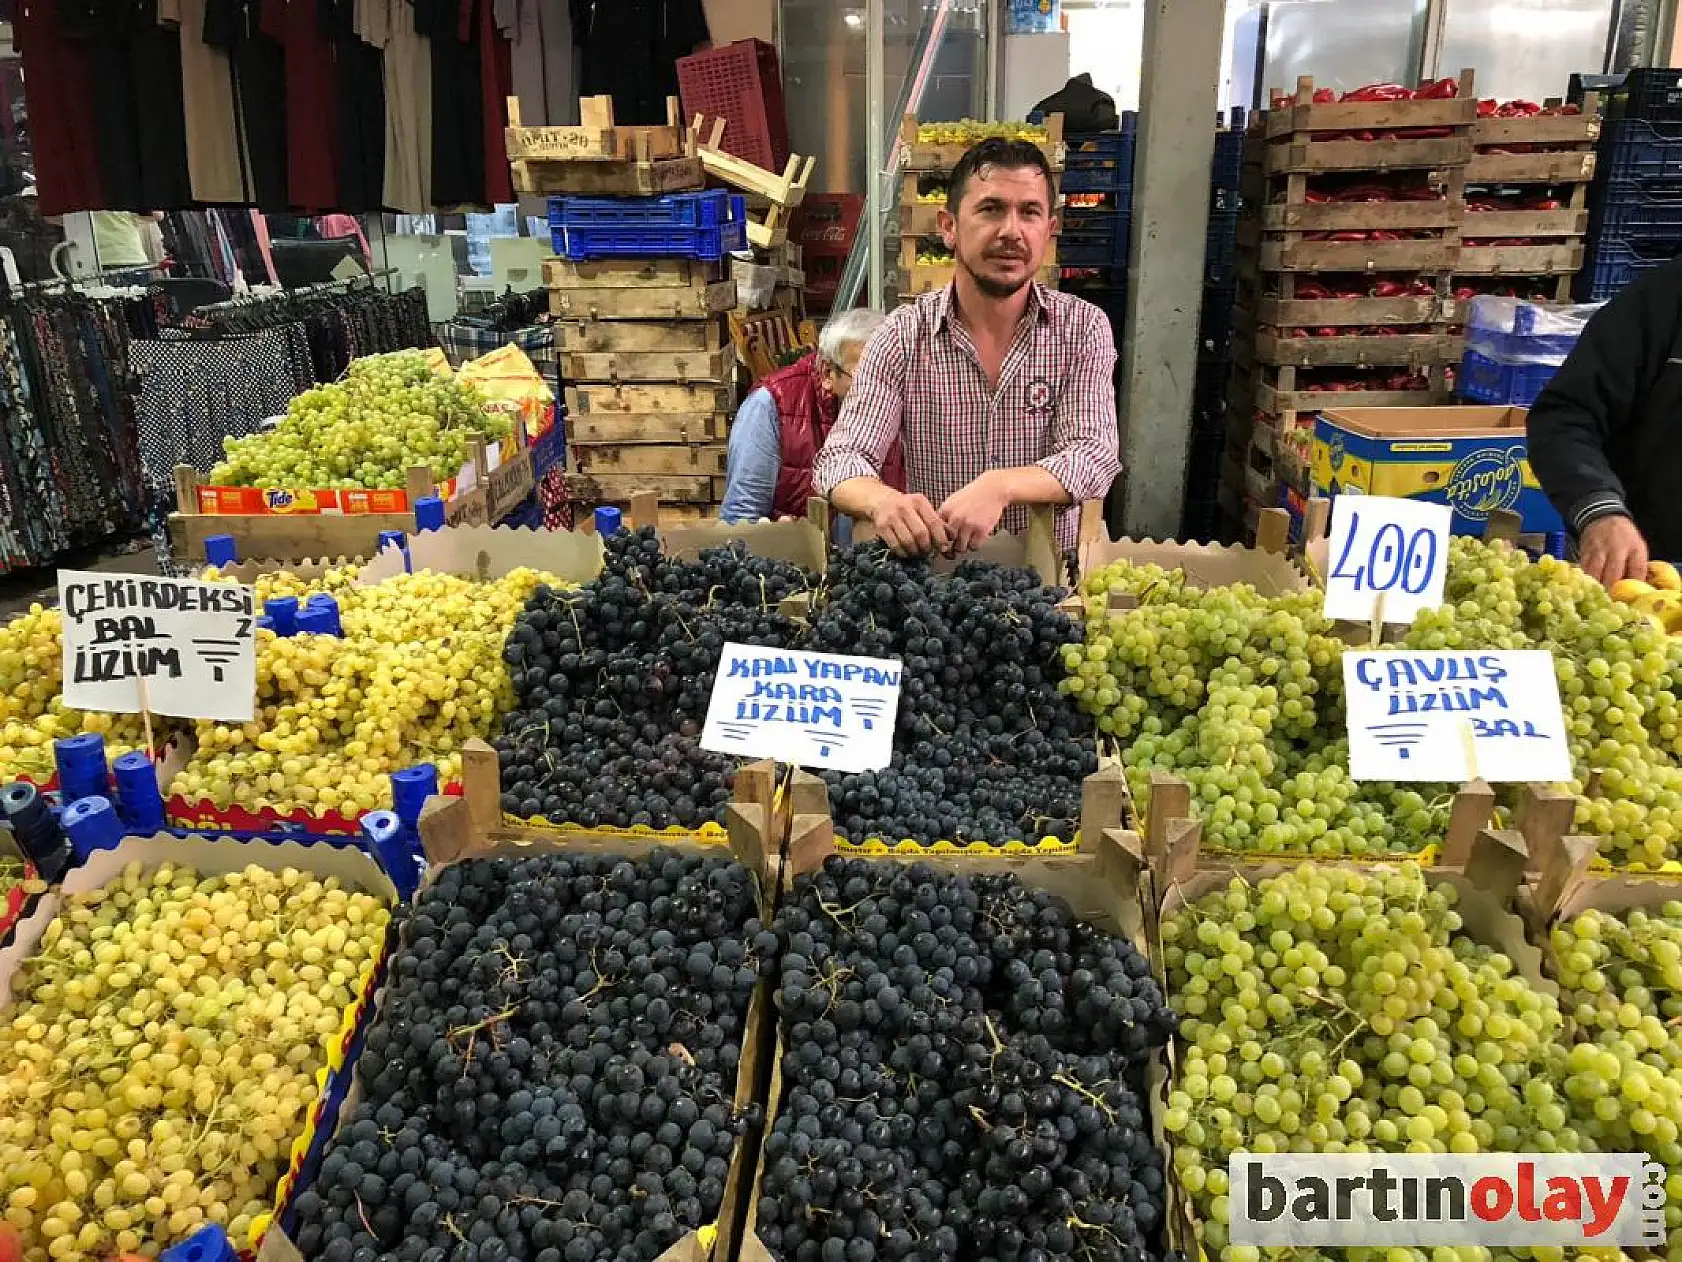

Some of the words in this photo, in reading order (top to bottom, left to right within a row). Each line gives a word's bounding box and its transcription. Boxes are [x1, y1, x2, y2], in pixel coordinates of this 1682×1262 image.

[266, 490, 293, 508] Tide
[1331, 511, 1437, 594] 400
[90, 615, 172, 645] BAL
[74, 643, 182, 683] ÜZÜM
[727, 656, 797, 678] KAN
[803, 658, 899, 686] YAPAN
[1356, 656, 1508, 691] ÇAVUŞ
[745, 680, 842, 702] KARA
[1387, 686, 1509, 715] ÜZÜM
[735, 698, 842, 728] ÜZÜM
[1470, 717, 1551, 739] BAL
